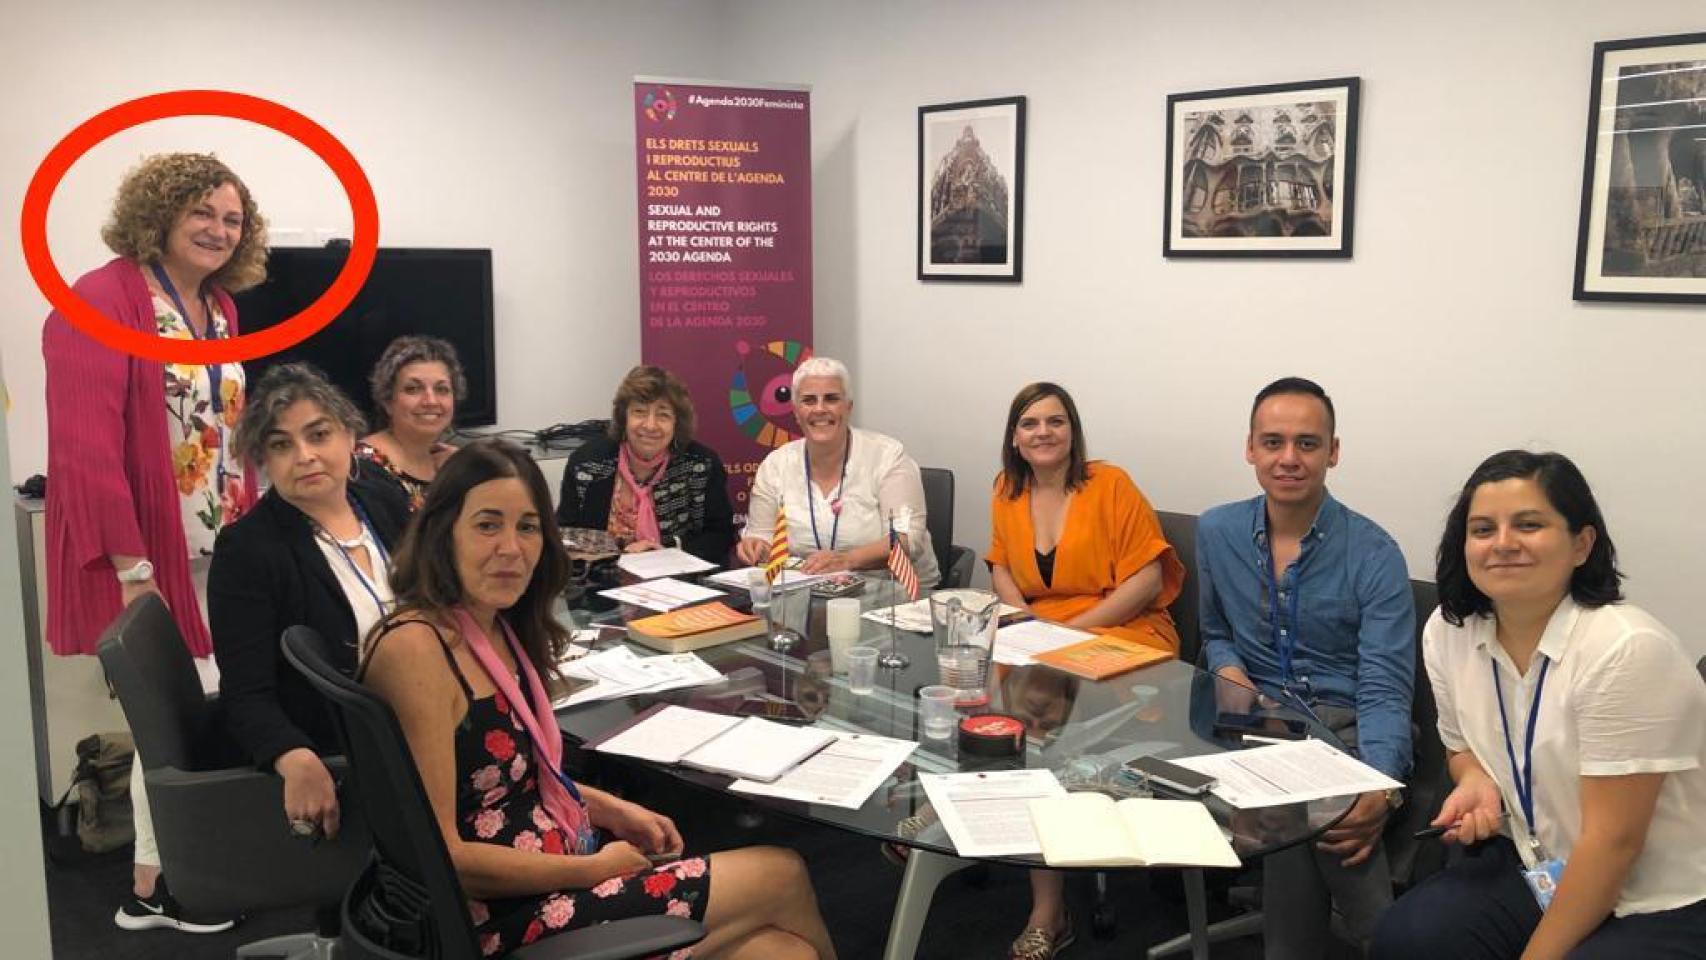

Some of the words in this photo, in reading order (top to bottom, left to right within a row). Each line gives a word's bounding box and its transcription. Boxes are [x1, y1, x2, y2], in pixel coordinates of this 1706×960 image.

[646, 138, 666, 149] ELS
[669, 139, 705, 151] DRETS
[708, 140, 759, 152] SEXUALS
[653, 155, 741, 167] REPRODUCTIUS
[647, 171, 662, 181] AL
[665, 171, 708, 182] CENTRE
[711, 172, 726, 182] DE
[728, 173, 784, 184] L'AGENDA
[648, 186, 678, 197] 2030
[648, 205, 693, 216] SEXUAL
[695, 206, 721, 216] AND
[648, 220, 734, 232] REPRODUCTIVE
[737, 222, 778, 232] RIGHTS
[648, 236, 662, 247] AT
[666, 236, 688, 247] THE
[690, 236, 733, 247] CENTER
[736, 237, 752, 247] OF
[754, 237, 774, 248] THE
[649, 252, 680, 262] 2030
[683, 252, 732, 263] AGENDA
[649, 271, 672, 281] LOS
[675, 271, 736, 281] DERECHOS
[739, 271, 794, 281] SEXUALES
[650, 286, 657, 296] Y
[660, 286, 757, 297] REPRODUCTIVOS
[682, 302, 730, 312] CENTRO
[684, 316, 733, 327] AGENDA
